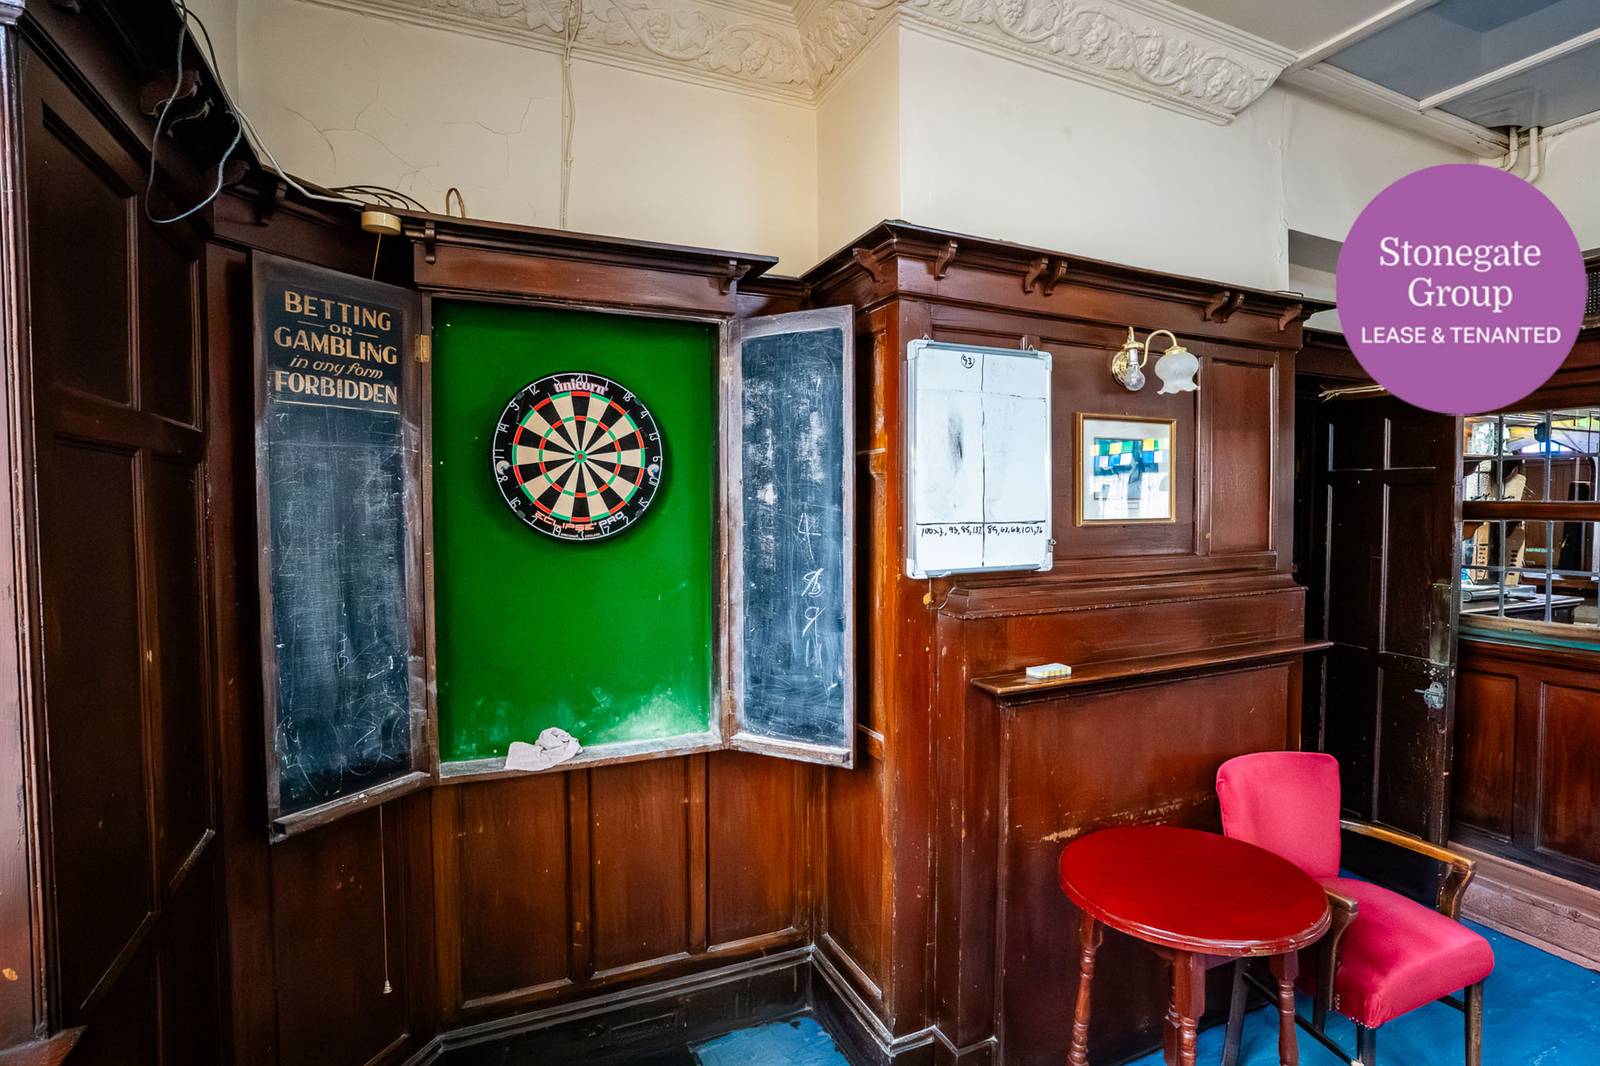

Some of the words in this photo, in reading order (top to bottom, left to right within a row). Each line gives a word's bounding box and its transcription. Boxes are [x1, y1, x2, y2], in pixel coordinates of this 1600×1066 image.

[284, 290, 391, 331] BETTING
[329, 323, 353, 336] OR
[274, 326, 398, 365] GAMBLING
[289, 354, 309, 369] in
[312, 360, 345, 377] any
[345, 362, 384, 379] form
[274, 369, 398, 405] FORBIDDEN
[553, 378, 606, 396] unicorn
[534, 510, 596, 531] ECLIPSE
[598, 511, 624, 527] PRO
